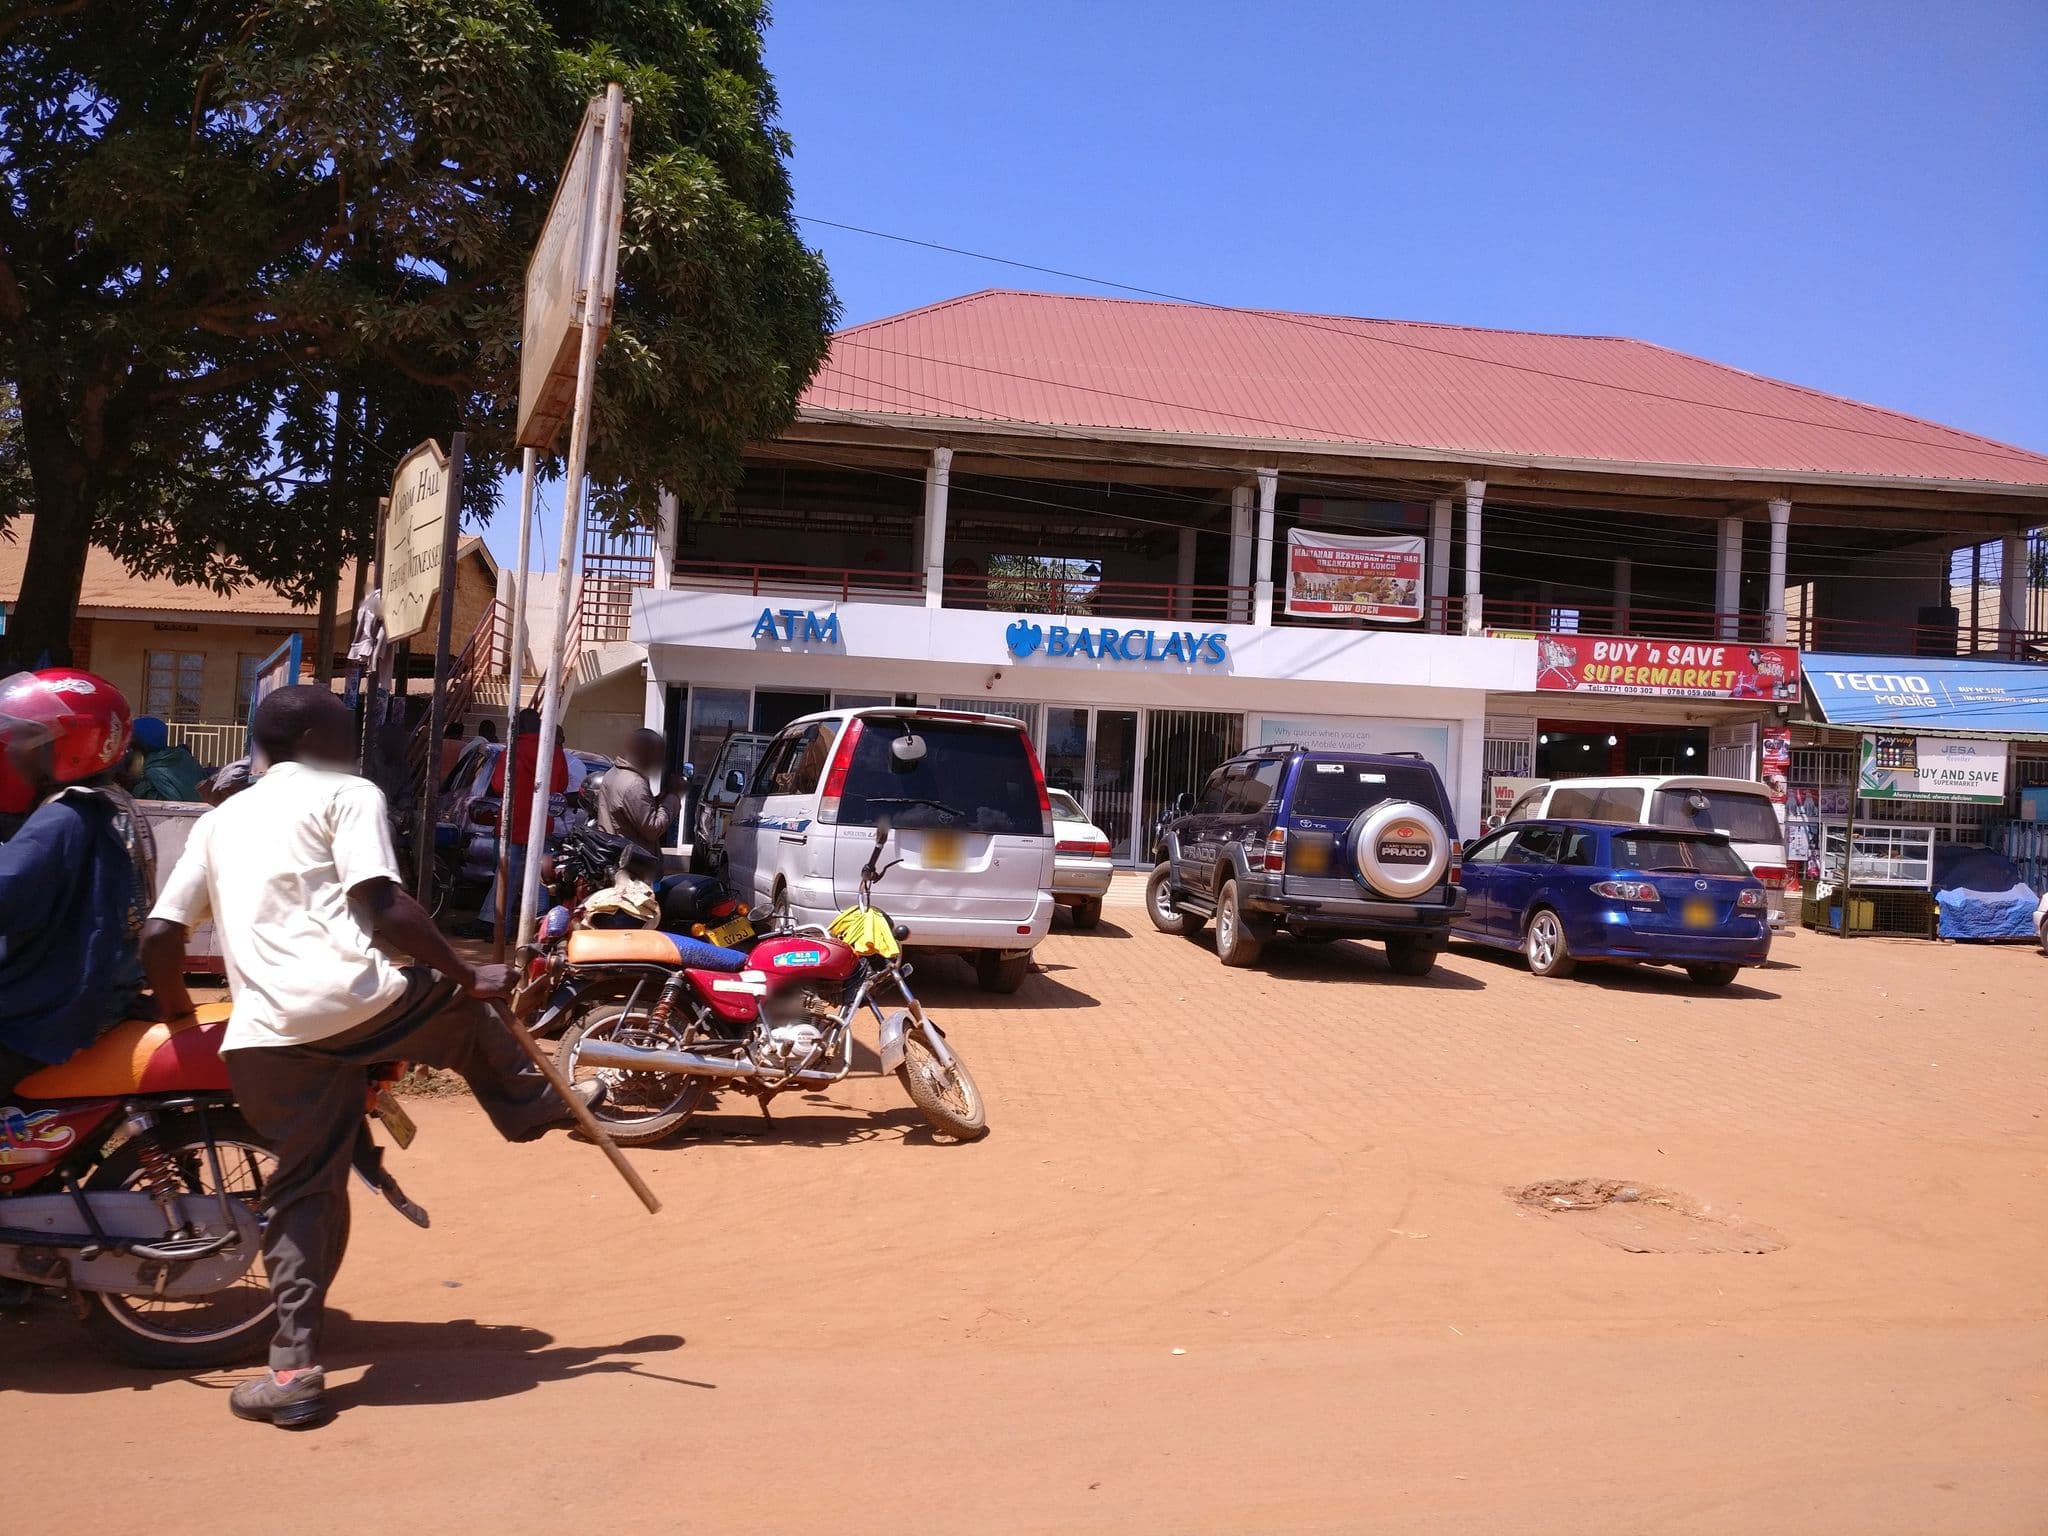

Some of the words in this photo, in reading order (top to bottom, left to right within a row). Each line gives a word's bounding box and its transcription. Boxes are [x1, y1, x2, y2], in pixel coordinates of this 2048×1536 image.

[1331, 603, 1352, 612] NOW
[1354, 605, 1379, 614] OPEN
[750, 606, 838, 645] ATM
[1047, 625, 1227, 665] BARCLAYS
[1593, 641, 1639, 663] BUY
[1667, 645, 1726, 666] SAVE
[1582, 663, 1737, 689] SUPERMARKET
[1824, 672, 1930, 694] TECNO
[1273, 728, 1290, 737] Why
[1319, 729, 1340, 738] when
[1311, 740, 1337, 748] Mobile
[1941, 745, 1976, 755] JESA
[1913, 768, 1937, 779] BUY
[1940, 770, 1965, 780] AND
[1968, 771, 1999, 782] SAVE
[1933, 779, 1979, 787] SUPERMARKET
[1494, 786, 1515, 798] Win
[1184, 845, 1217, 861] PRADO
[1381, 848, 1427, 857] PRADO
